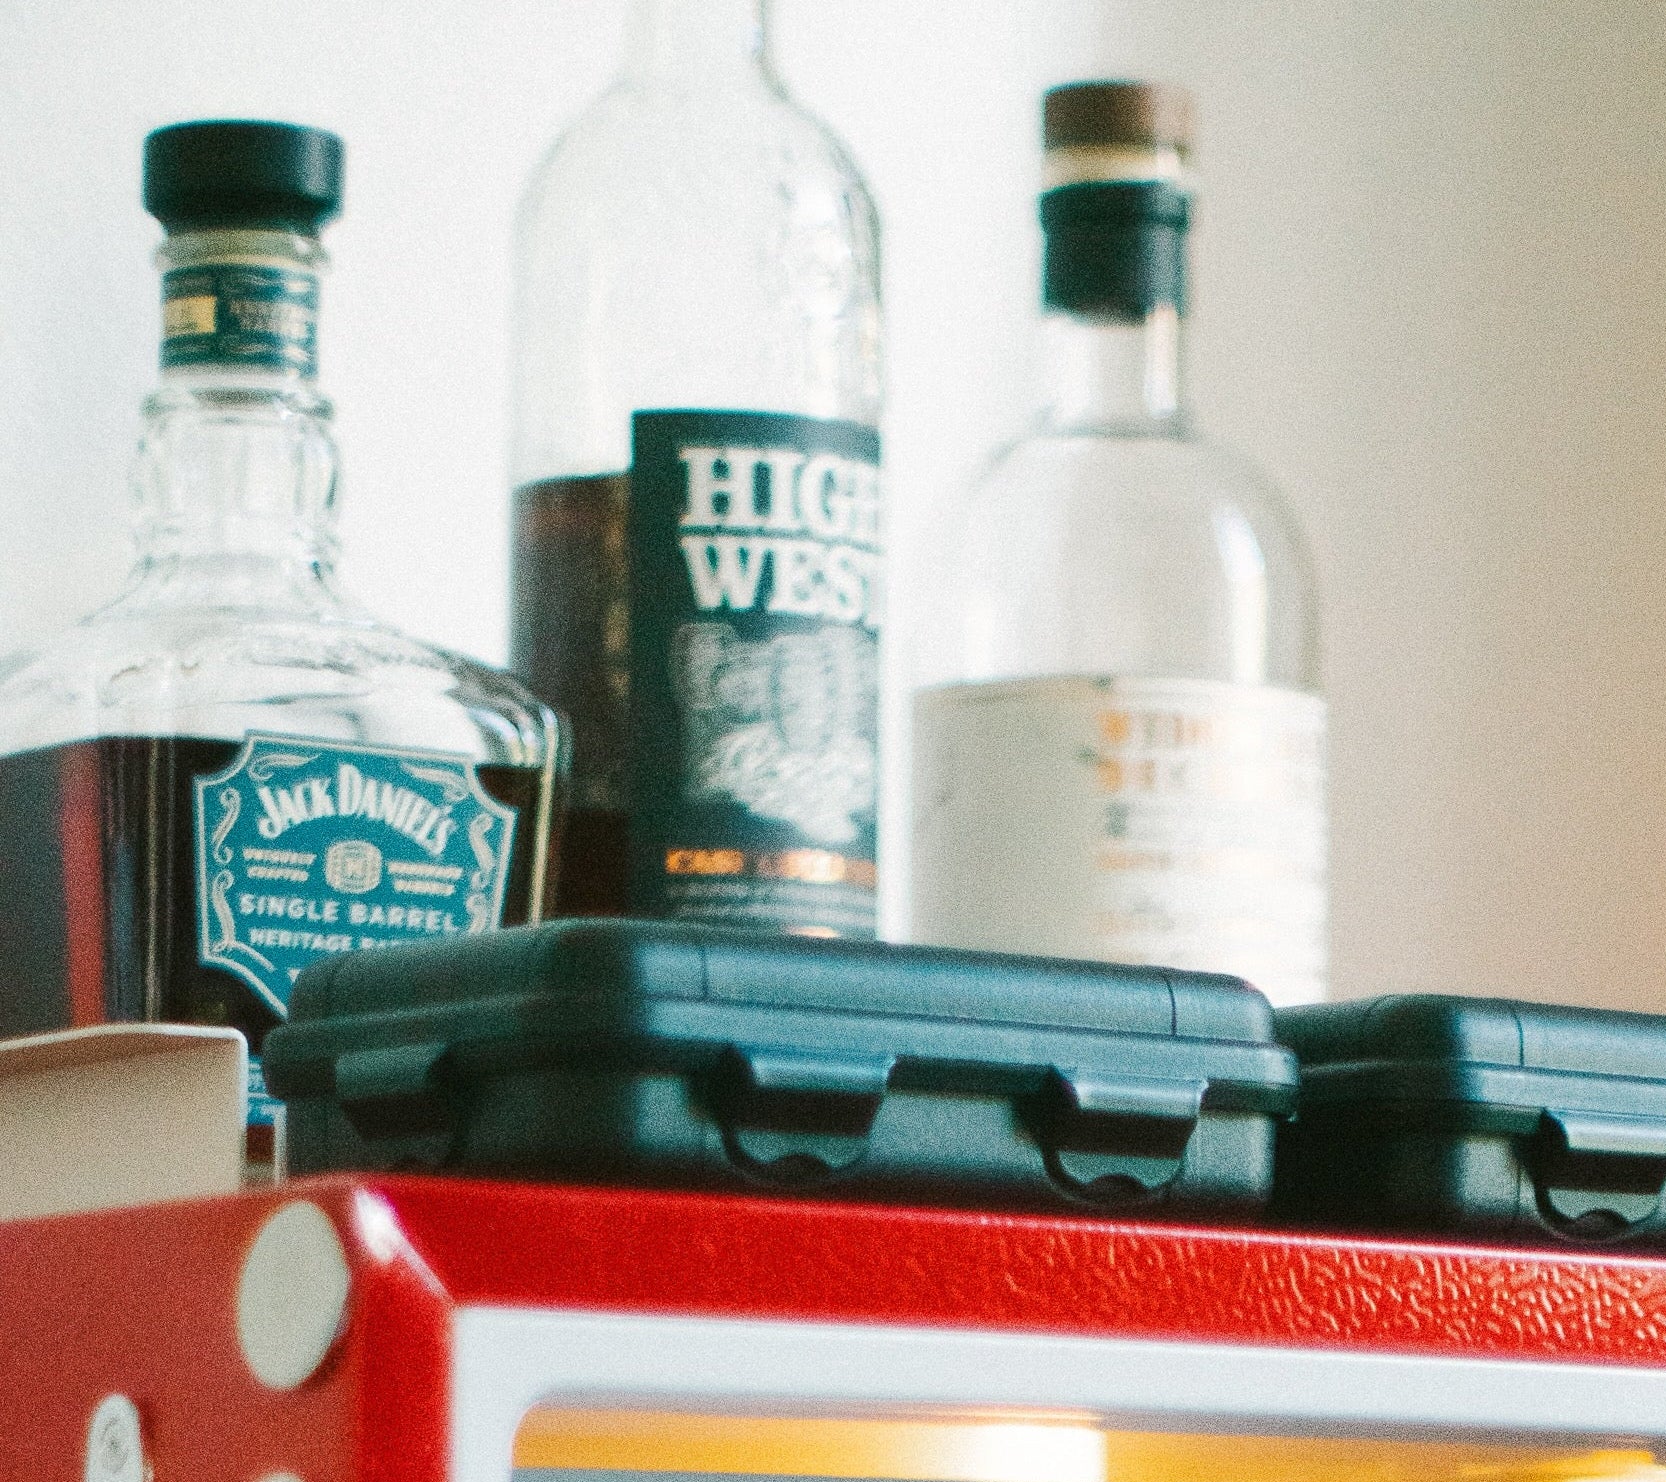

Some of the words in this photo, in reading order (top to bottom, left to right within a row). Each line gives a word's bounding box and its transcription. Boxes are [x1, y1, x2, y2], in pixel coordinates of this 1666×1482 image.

[680, 536, 880, 625] WES
[257, 777, 336, 840] JACK
[338, 762, 459, 856] DANIEL'S
[239, 894, 339, 924] SINGLE
[350, 901, 459, 933] BARREL
[249, 928, 352, 951] HERITAGE
